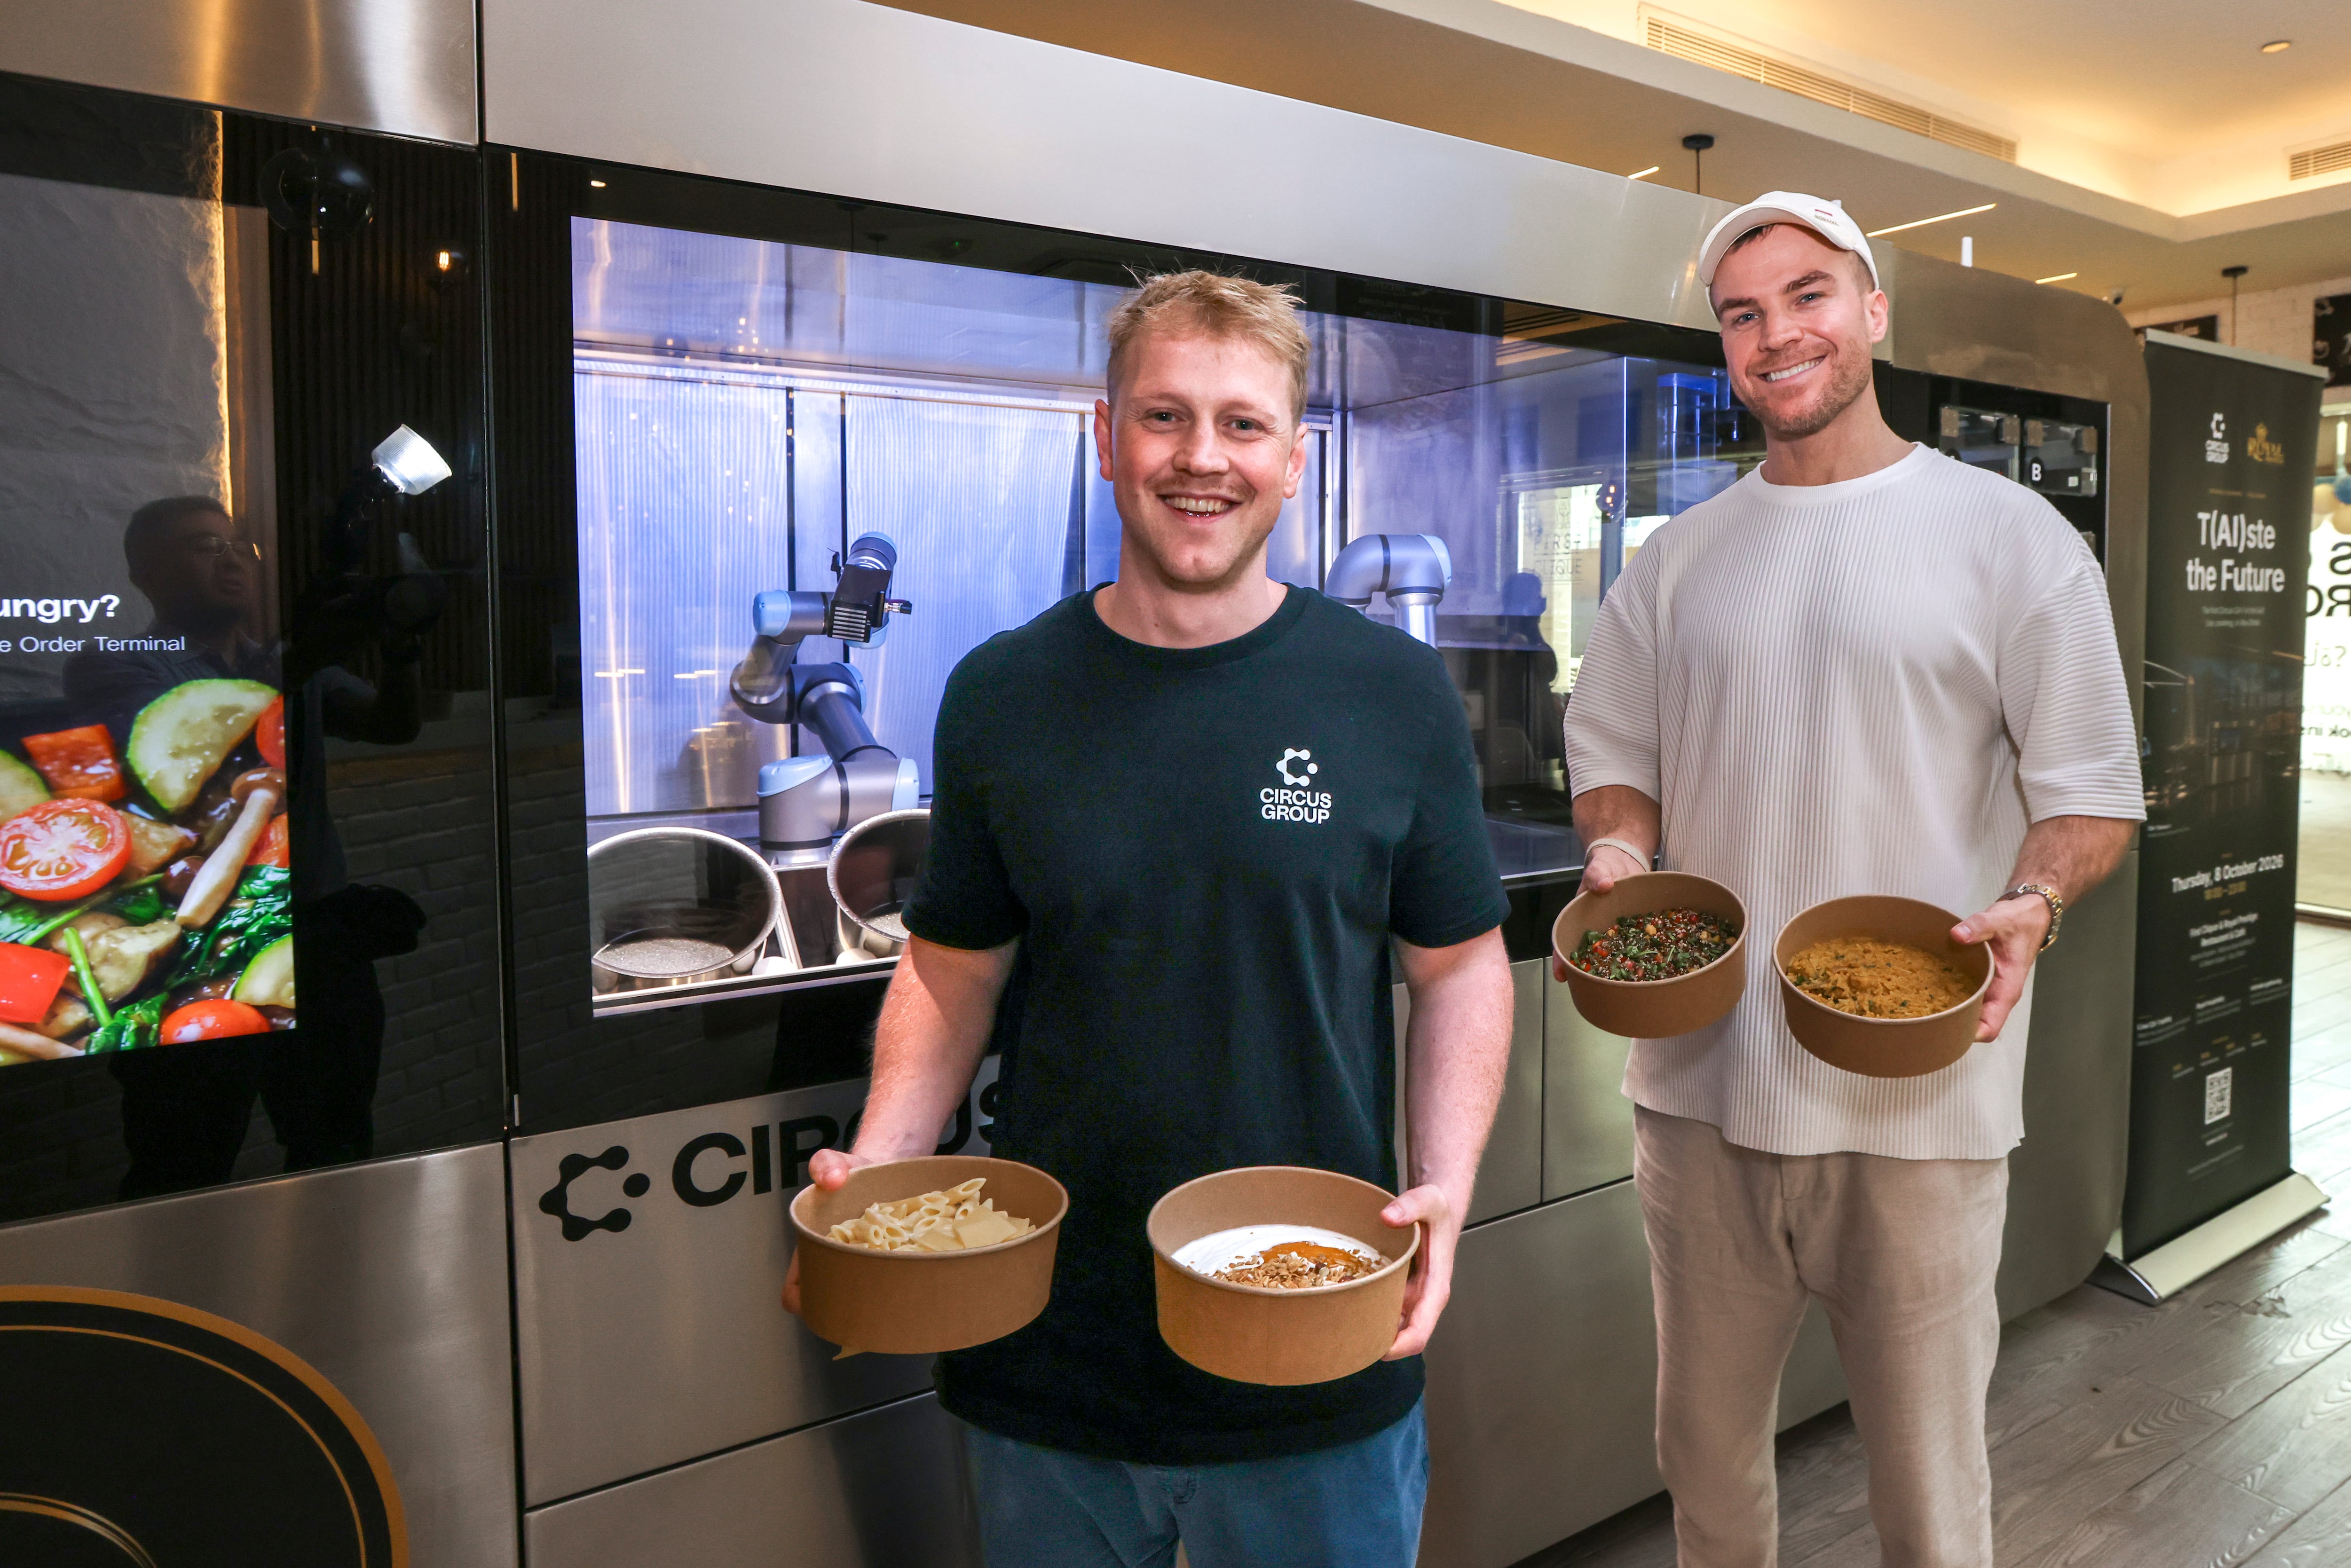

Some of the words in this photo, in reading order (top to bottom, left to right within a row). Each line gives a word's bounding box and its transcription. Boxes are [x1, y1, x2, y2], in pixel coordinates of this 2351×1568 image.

[2031, 463, 2042, 481] B
[2197, 510, 2276, 552] T(AI)ste
[2186, 559, 2217, 591] the
[2221, 559, 2285, 593] Future
[19, 636, 86, 653] Order
[94, 636, 186, 652] Terminal
[1259, 788, 1332, 809] CIRCUS
[1261, 804, 1330, 825] GROUP
[672, 1080, 1000, 1208] CIR
